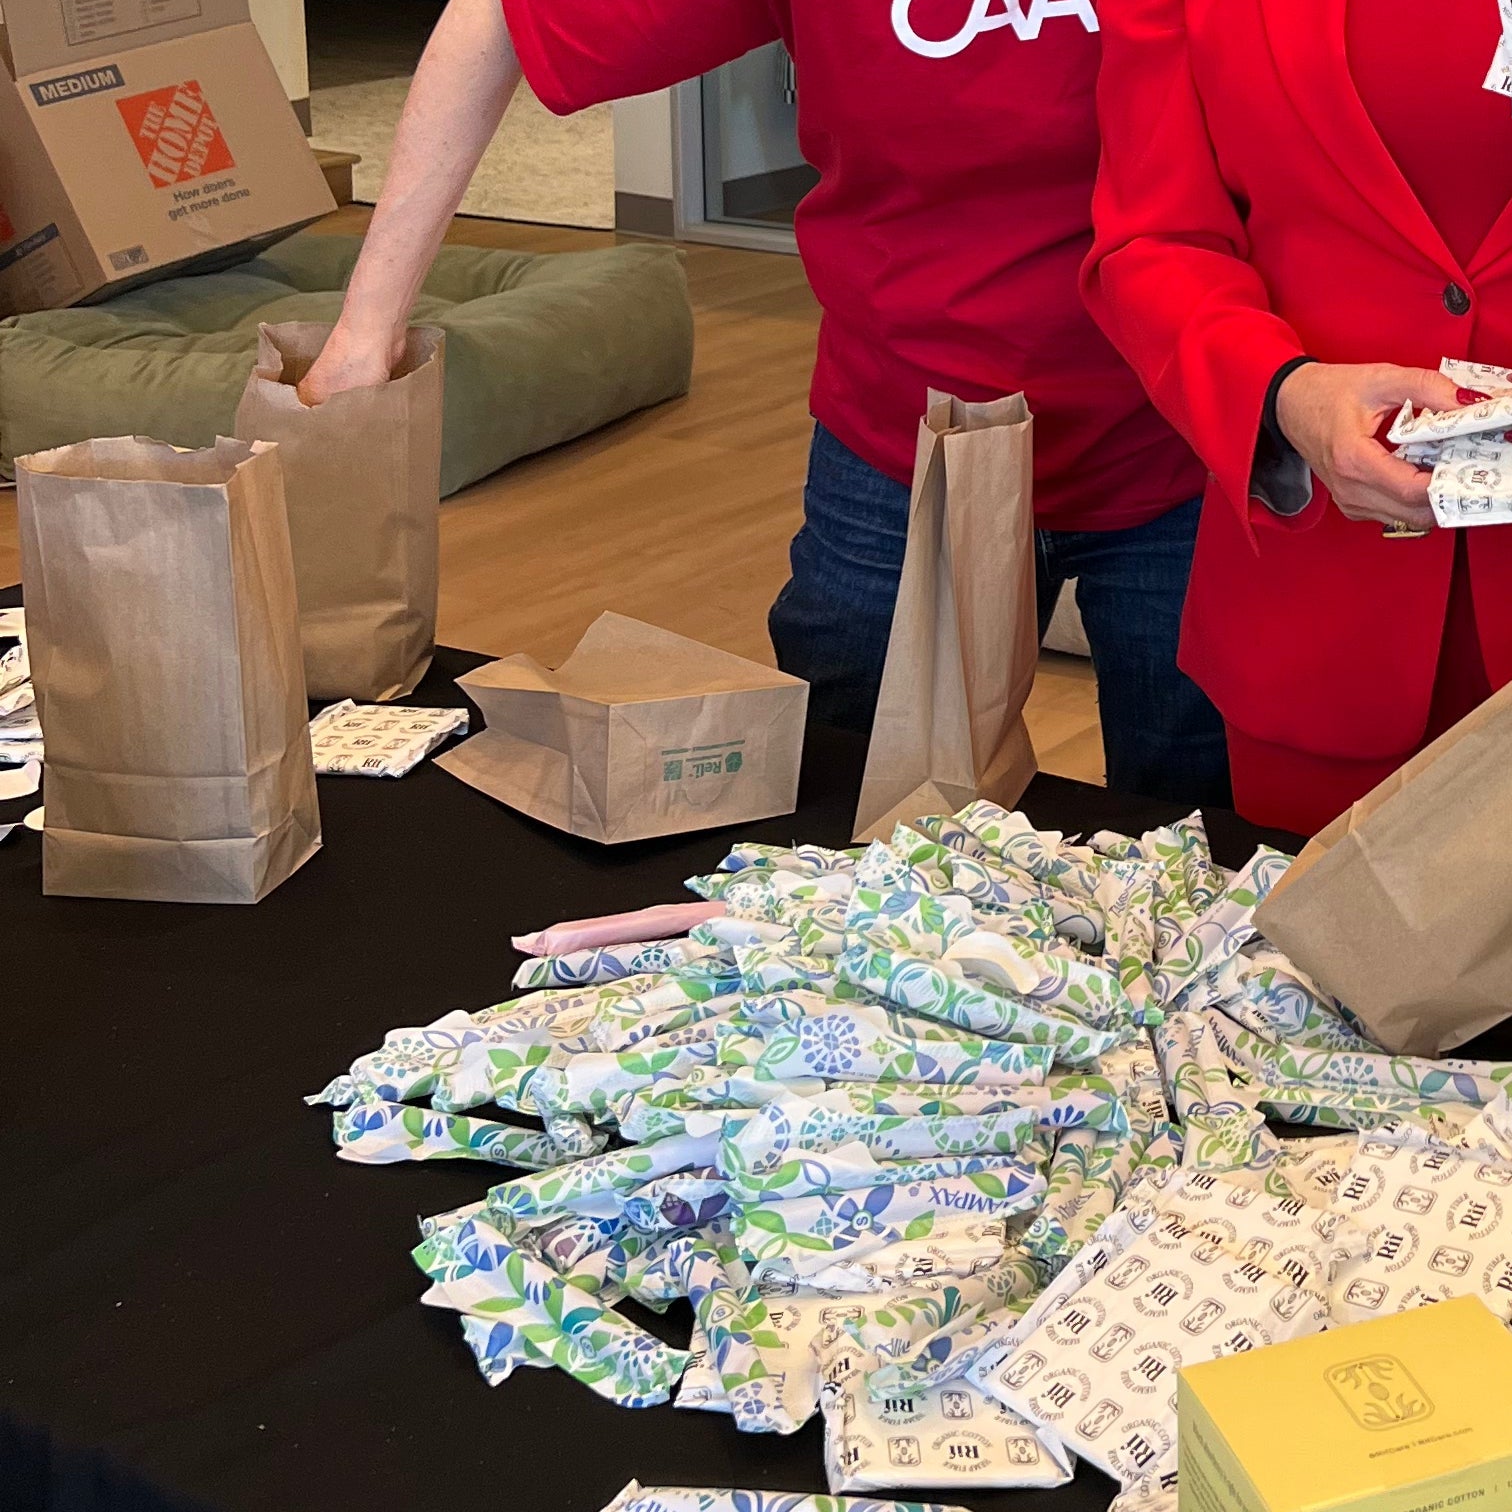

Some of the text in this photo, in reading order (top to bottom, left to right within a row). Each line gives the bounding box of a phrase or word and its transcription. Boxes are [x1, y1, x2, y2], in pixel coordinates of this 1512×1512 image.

[38, 69, 117, 101] MEDIUM
[139, 100, 168, 139] THE
[148, 83, 204, 184] HOME
[183, 113, 219, 177] DEPOT
[168, 204, 189, 221] get
[221, 188, 251, 203] done
[173, 189, 200, 203] How
[928, 1186, 1007, 1215] AMPAX
[1343, 1174, 1371, 1201] Rif
[1460, 1201, 1488, 1229] Rif
[1159, 1219, 1192, 1241] Rif
[1377, 1231, 1404, 1261] Rif
[1233, 1261, 1267, 1284] Rif
[1281, 1259, 1310, 1288] Rif
[1145, 1282, 1179, 1307] Rif
[1058, 1309, 1091, 1335] Rif
[1133, 1355, 1167, 1382] Rif
[1041, 1382, 1075, 1410] Rif
[949, 1444, 979, 1460] Rif
[1122, 1434, 1156, 1468] Rif
[1447, 1488, 1485, 1506] COTTON
